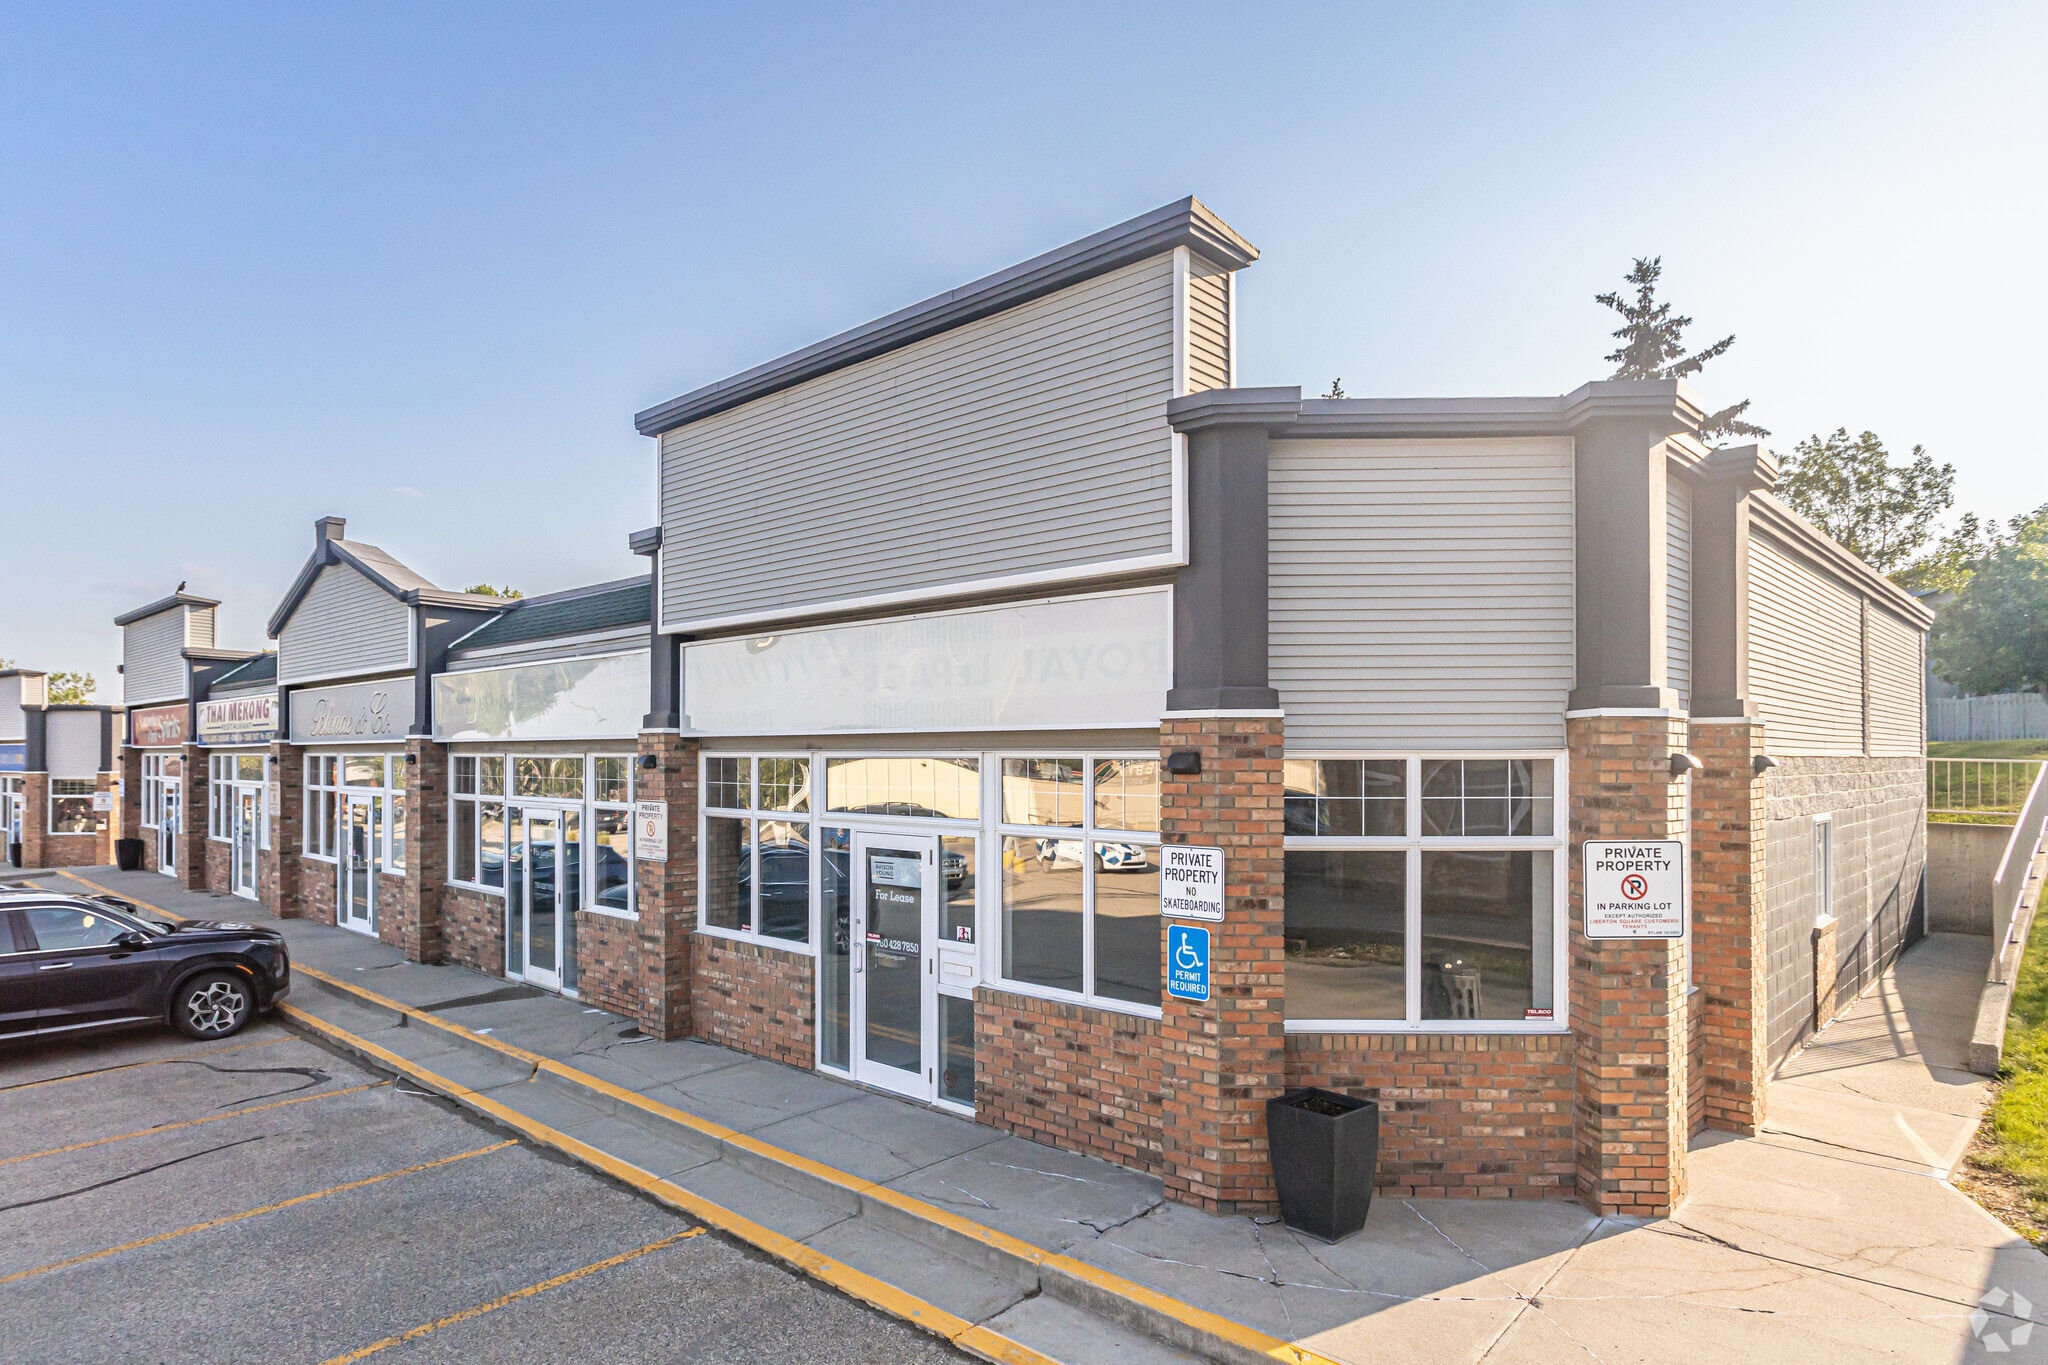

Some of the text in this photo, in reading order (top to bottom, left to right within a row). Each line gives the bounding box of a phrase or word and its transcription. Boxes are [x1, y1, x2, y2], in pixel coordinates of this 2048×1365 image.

[206, 698, 270, 723] THAI MEKONG
[641, 804, 661, 812] PRIVATE
[638, 812, 664, 820] PROPERTY
[1171, 852, 1212, 868] PRIVATE
[1605, 848, 1662, 859] PRIVATE
[1596, 860, 1671, 871] PROPERTY
[1165, 868, 1218, 884] PROPERTY
[875, 889, 915, 904] For Lease
[1186, 886, 1196, 897] NO
[1163, 897, 1221, 914] SKATEBOARDING
[888, 939, 902, 950] 428
[902, 941, 919, 953] 7850
[1175, 969, 1201, 982] PERMIT
[1170, 979, 1206, 995] REQUIRED
